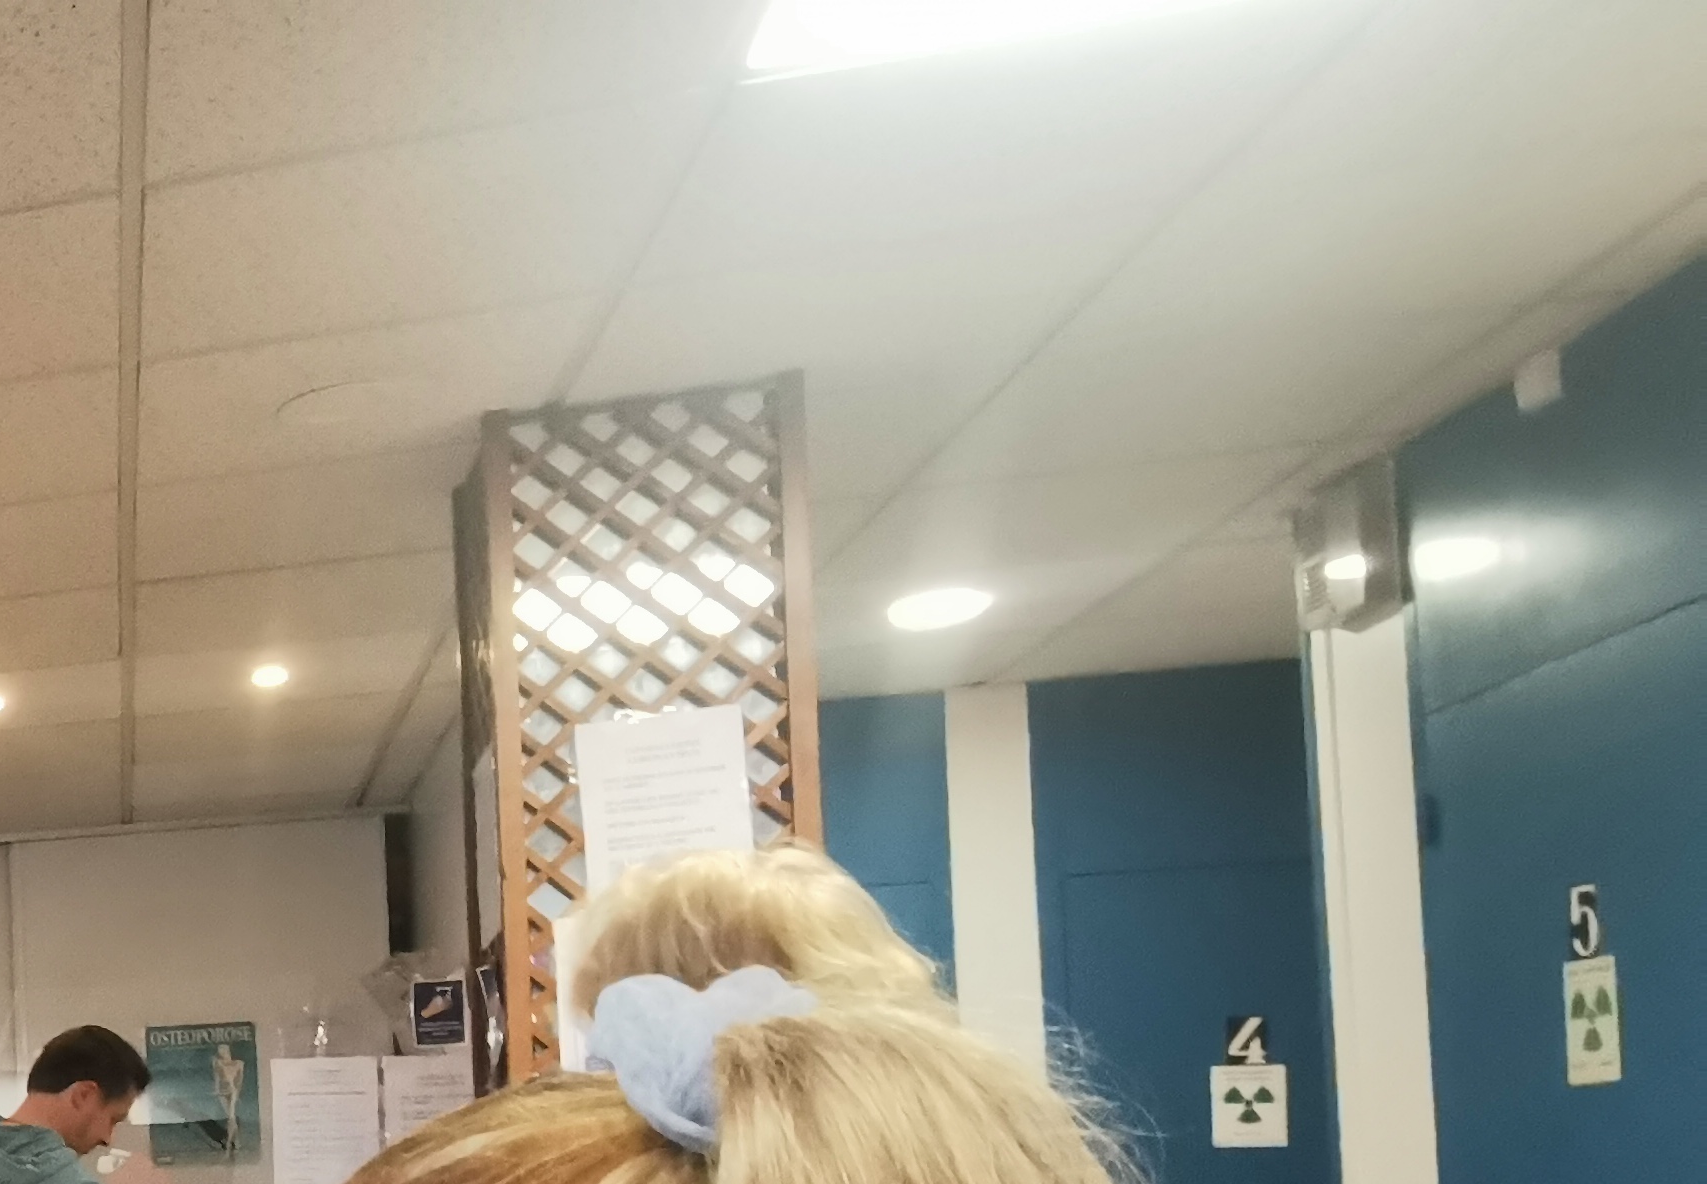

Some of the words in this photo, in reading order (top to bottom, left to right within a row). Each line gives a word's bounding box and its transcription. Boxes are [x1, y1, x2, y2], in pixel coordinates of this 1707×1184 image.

[1570, 884, 1600, 957] 5
[150, 1025, 253, 1047] OSTEOPOROSE
[1228, 1016, 1268, 1064] 4
